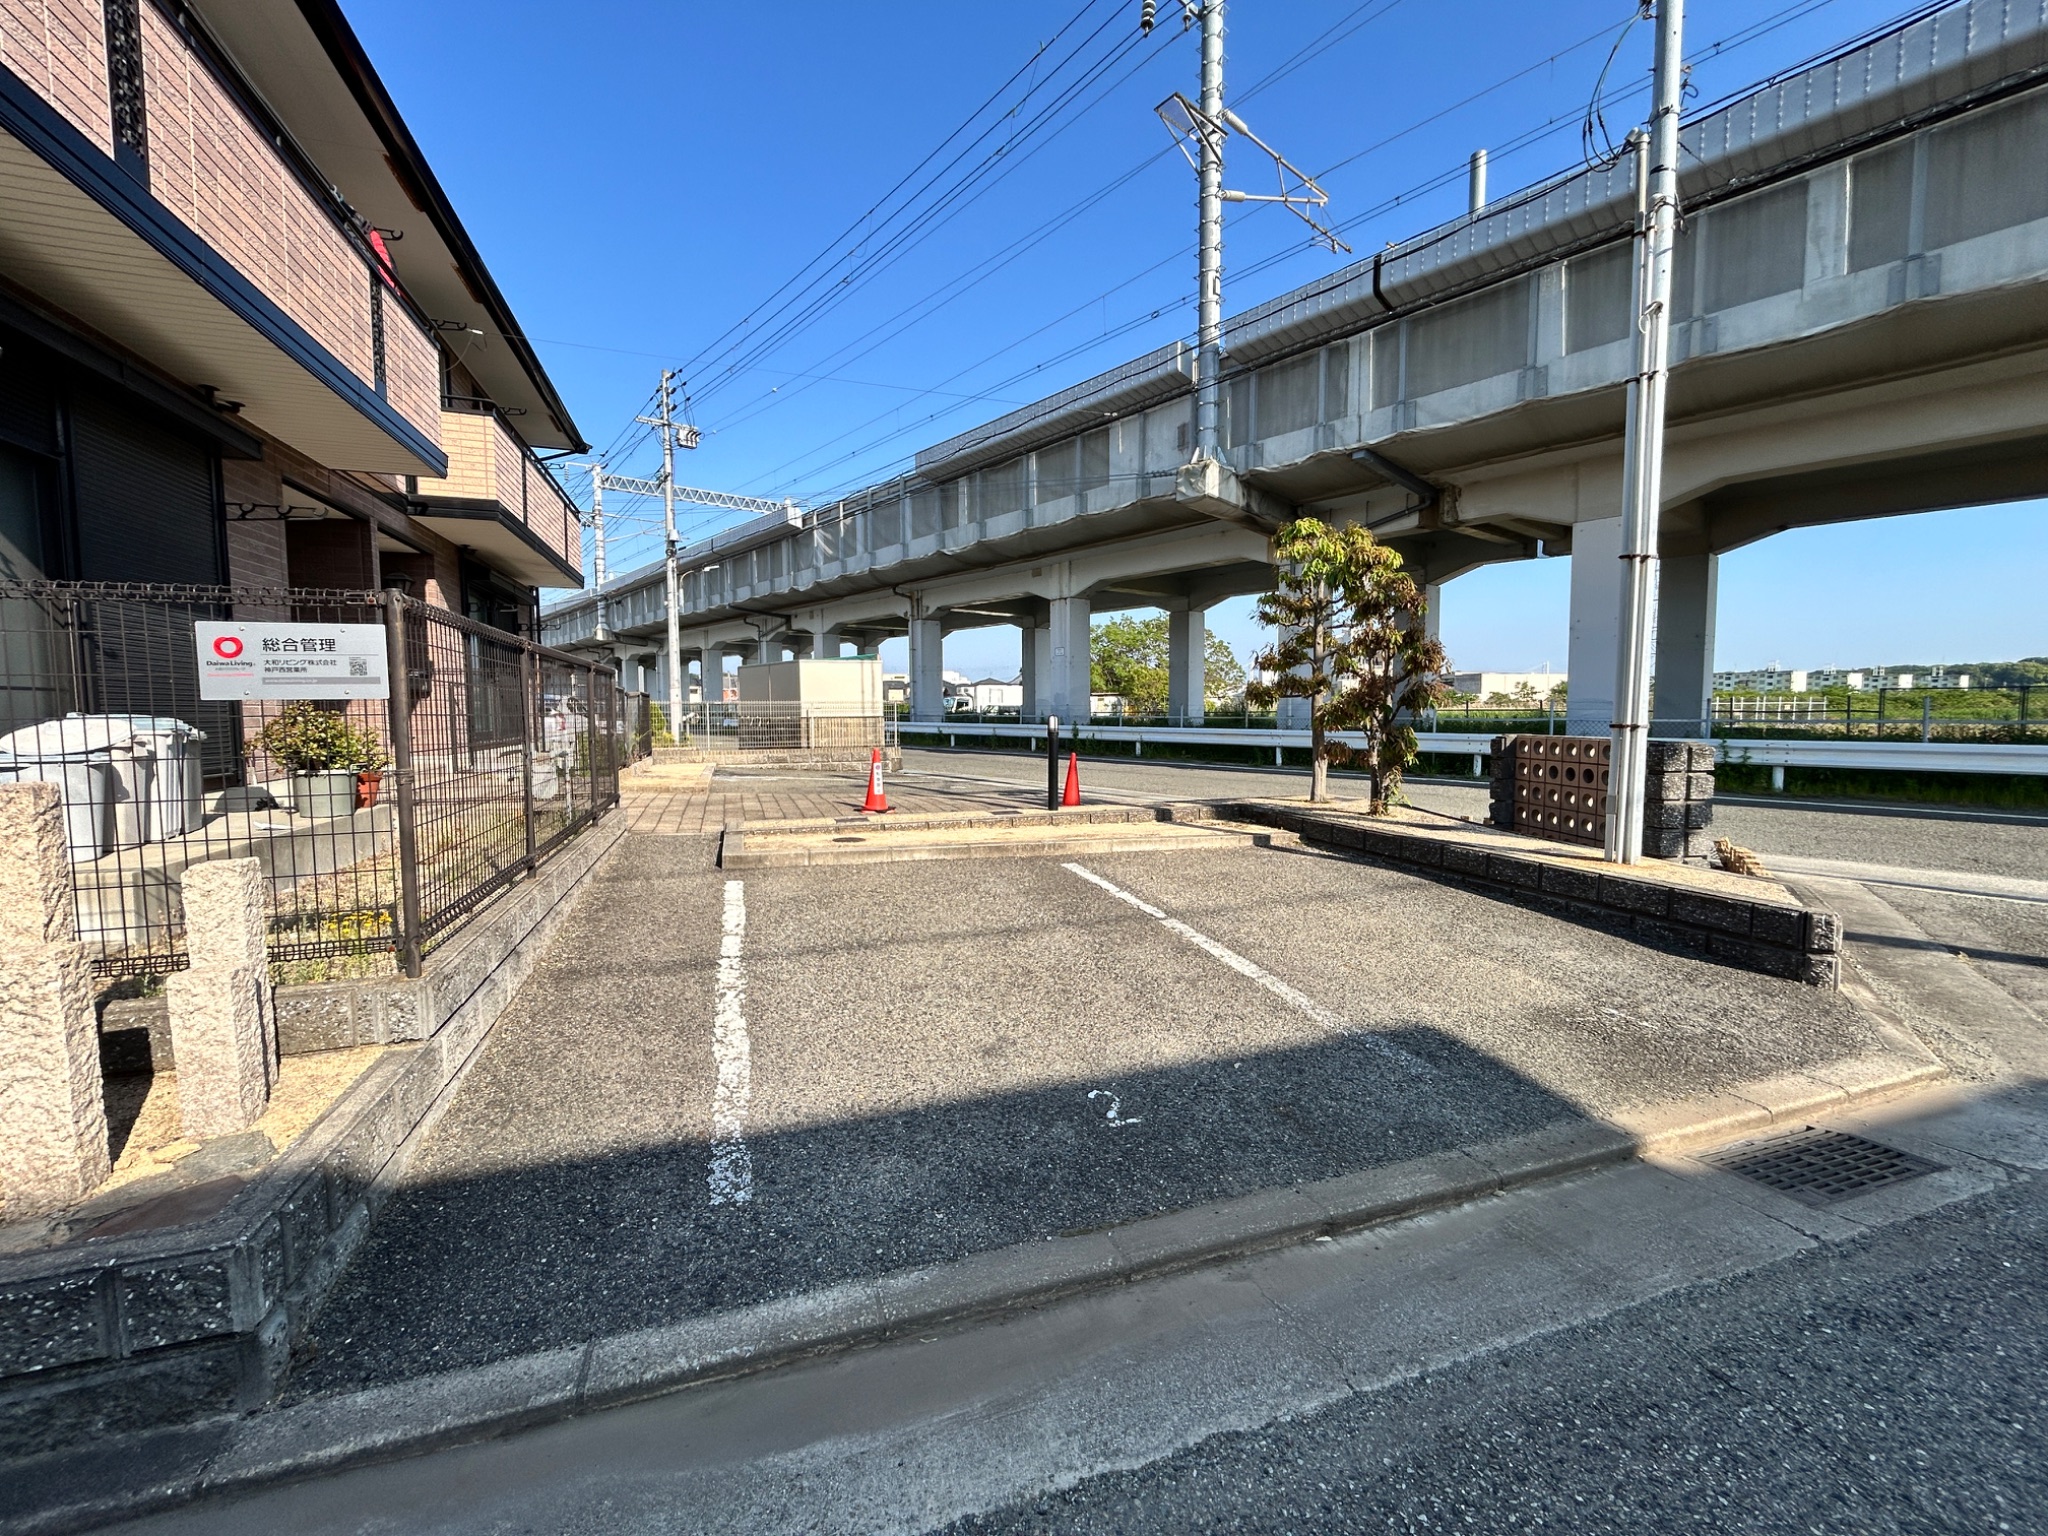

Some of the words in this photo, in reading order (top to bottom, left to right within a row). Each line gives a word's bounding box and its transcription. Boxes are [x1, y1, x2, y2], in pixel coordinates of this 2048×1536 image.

[262, 638, 336, 652] 総合管理
[1087, 1089, 1142, 1128] 2
